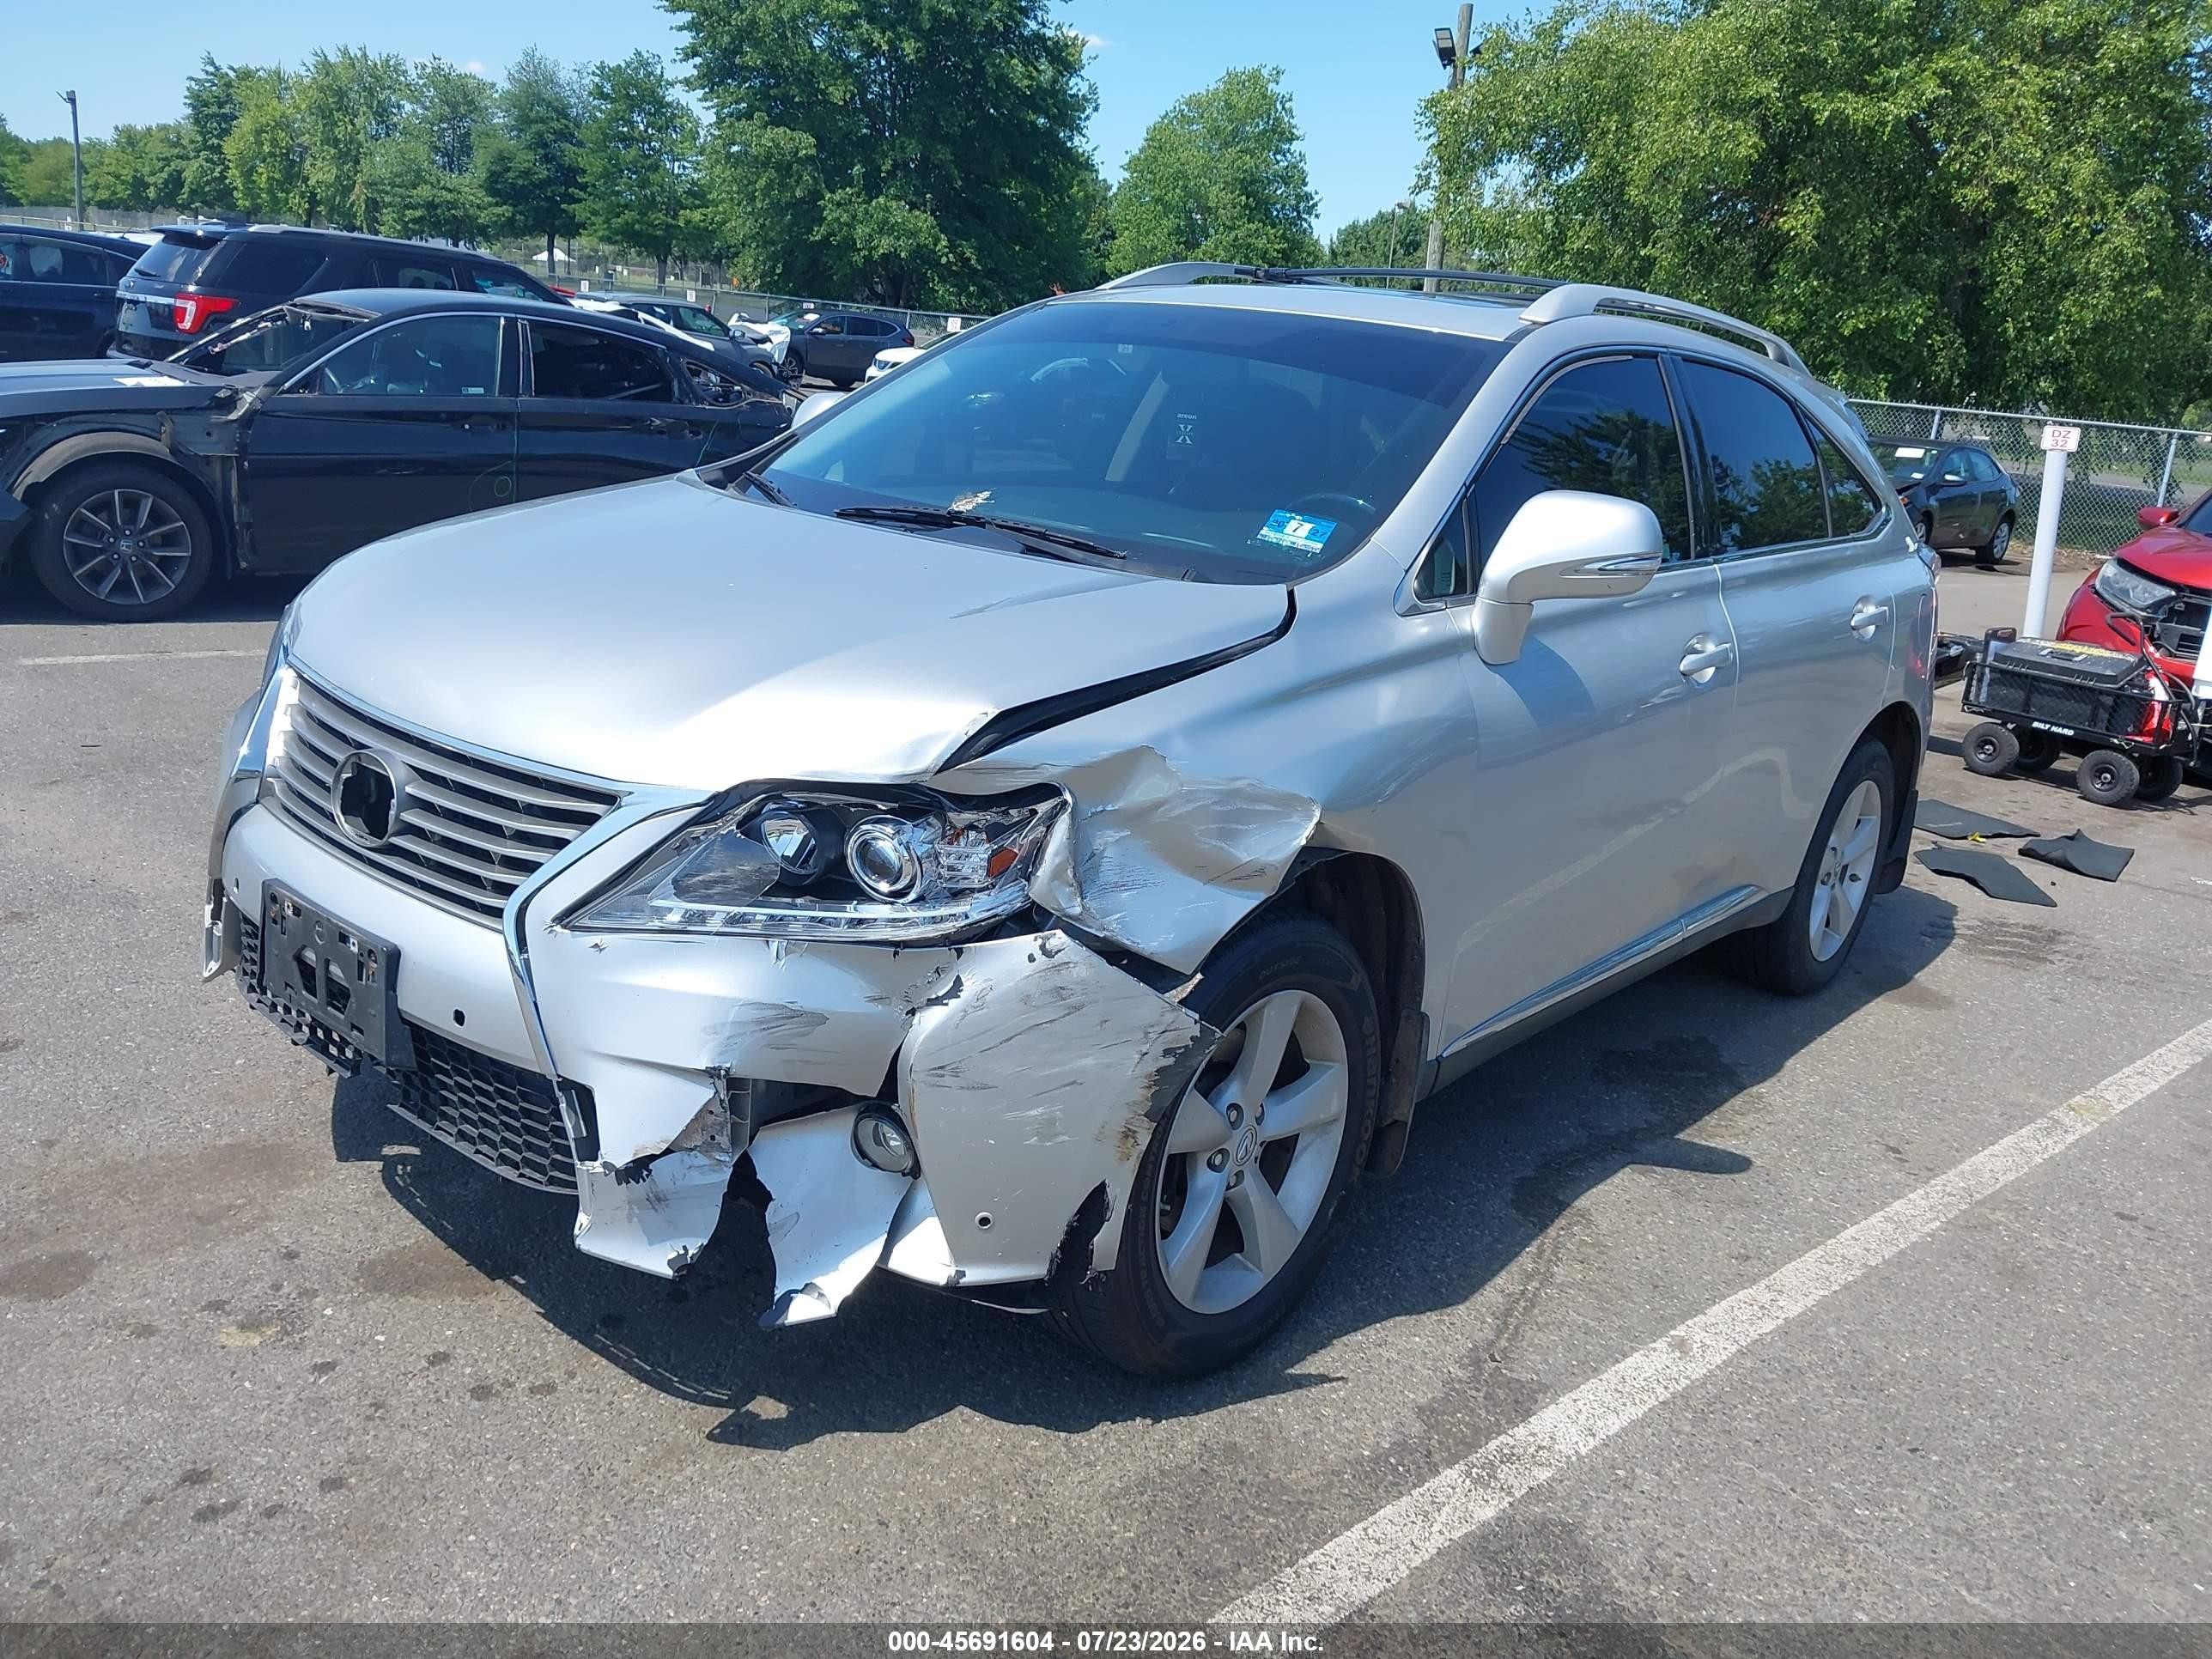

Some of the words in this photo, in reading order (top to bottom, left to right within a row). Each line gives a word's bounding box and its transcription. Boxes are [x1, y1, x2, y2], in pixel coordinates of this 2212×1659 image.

[2052, 429, 2071, 439] DZ
[2051, 439, 2068, 447] 32
[1291, 522, 1304, 533] 7
[2032, 721, 2051, 730] BILT
[2051, 726, 2075, 736] HARD
